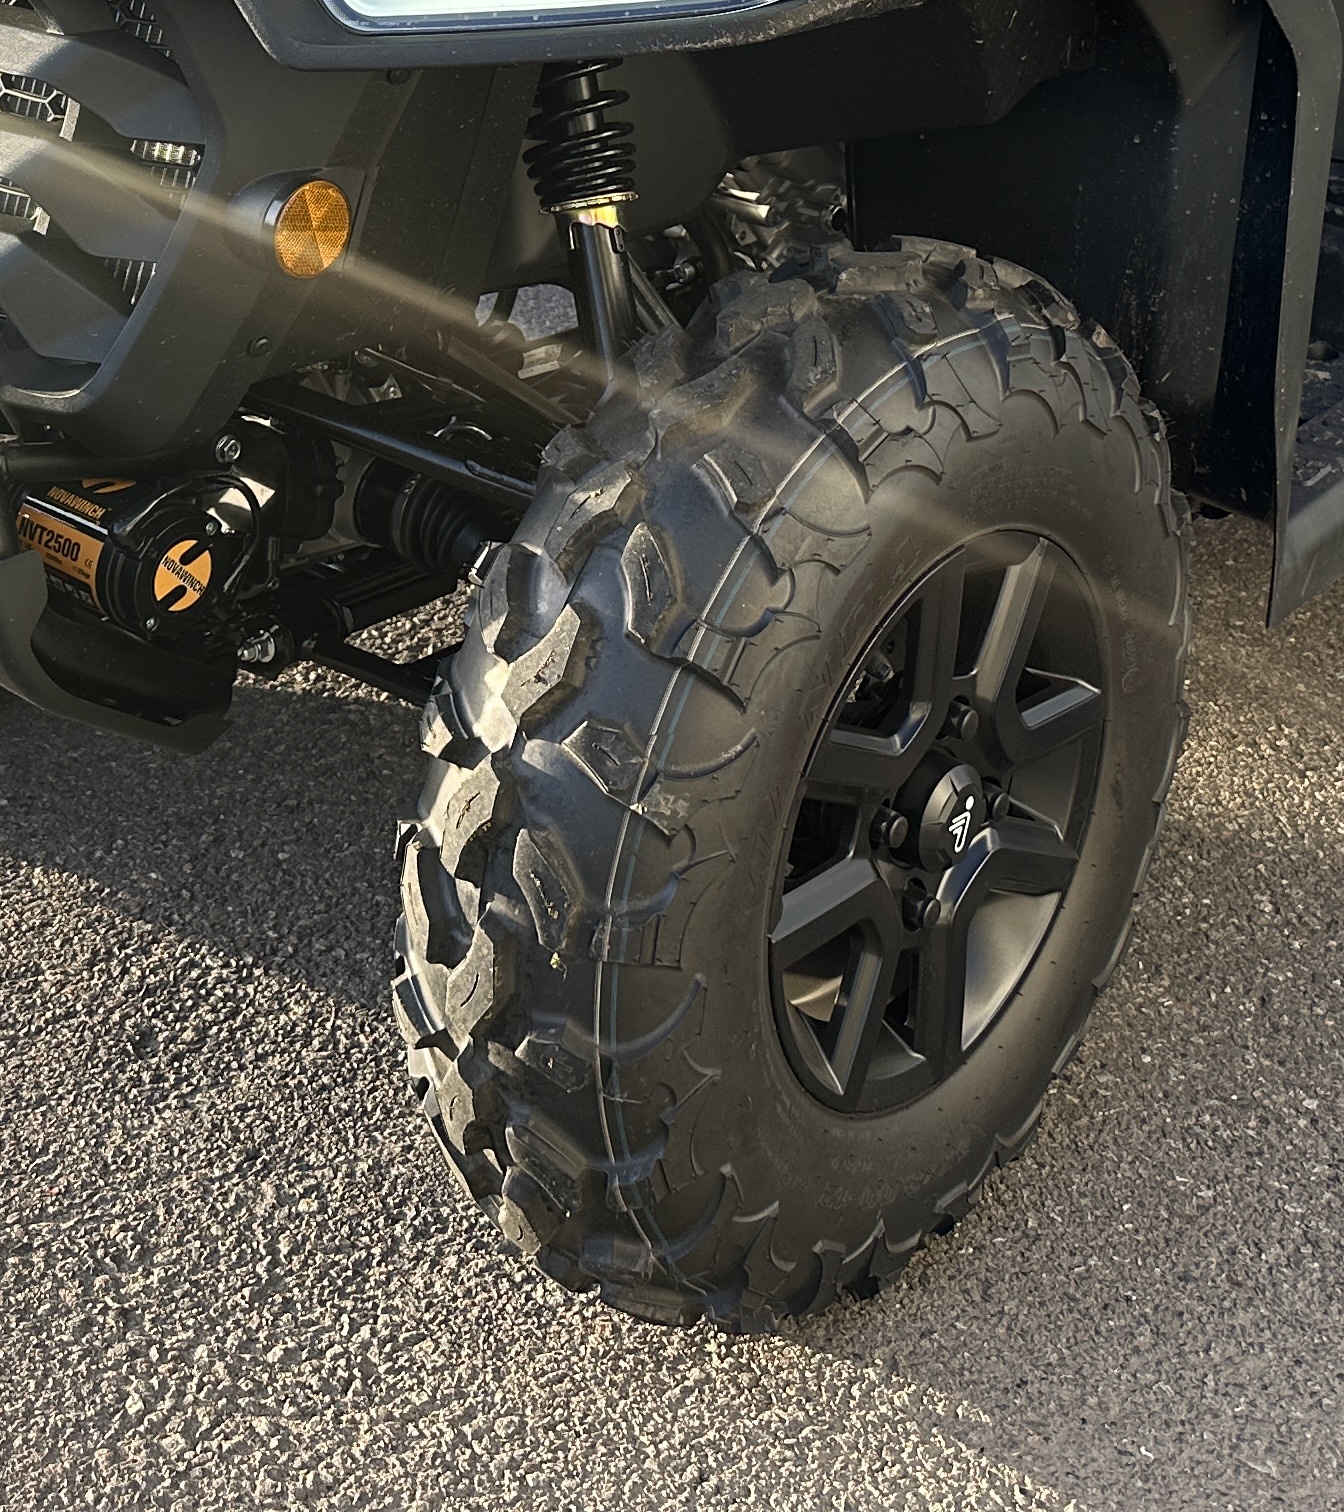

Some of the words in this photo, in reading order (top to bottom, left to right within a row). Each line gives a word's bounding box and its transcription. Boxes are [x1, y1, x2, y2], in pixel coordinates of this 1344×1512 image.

[46, 486, 106, 521] NOVAWINCH
[18, 515, 82, 563] NVT2500
[161, 554, 206, 596] NOVAWINCH
